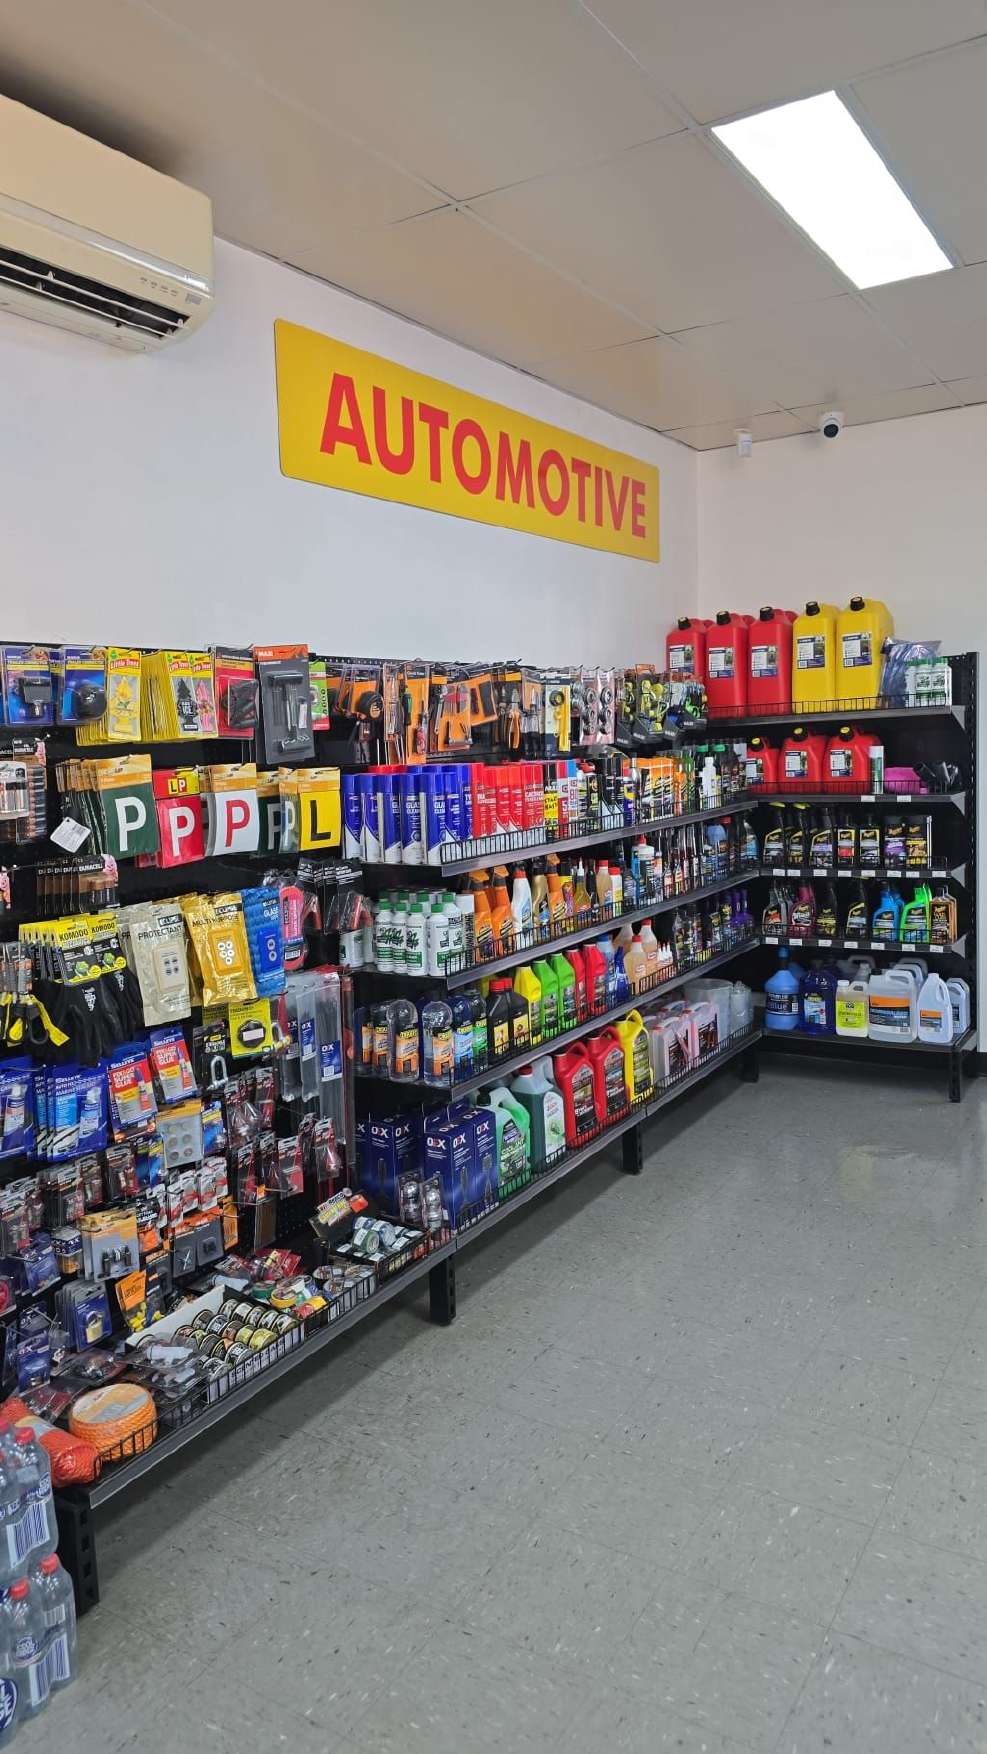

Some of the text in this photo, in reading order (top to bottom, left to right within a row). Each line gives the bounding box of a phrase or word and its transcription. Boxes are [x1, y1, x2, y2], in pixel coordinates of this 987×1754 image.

[320, 372, 646, 539] AUTOMOTIVE
[114, 796, 147, 852] P
[168, 806, 195, 857] P
[225, 799, 251, 848] P
[310, 799, 331, 841] L
[60, 928, 89, 941] KOMODO
[138, 925, 182, 941] PROTECTANT
